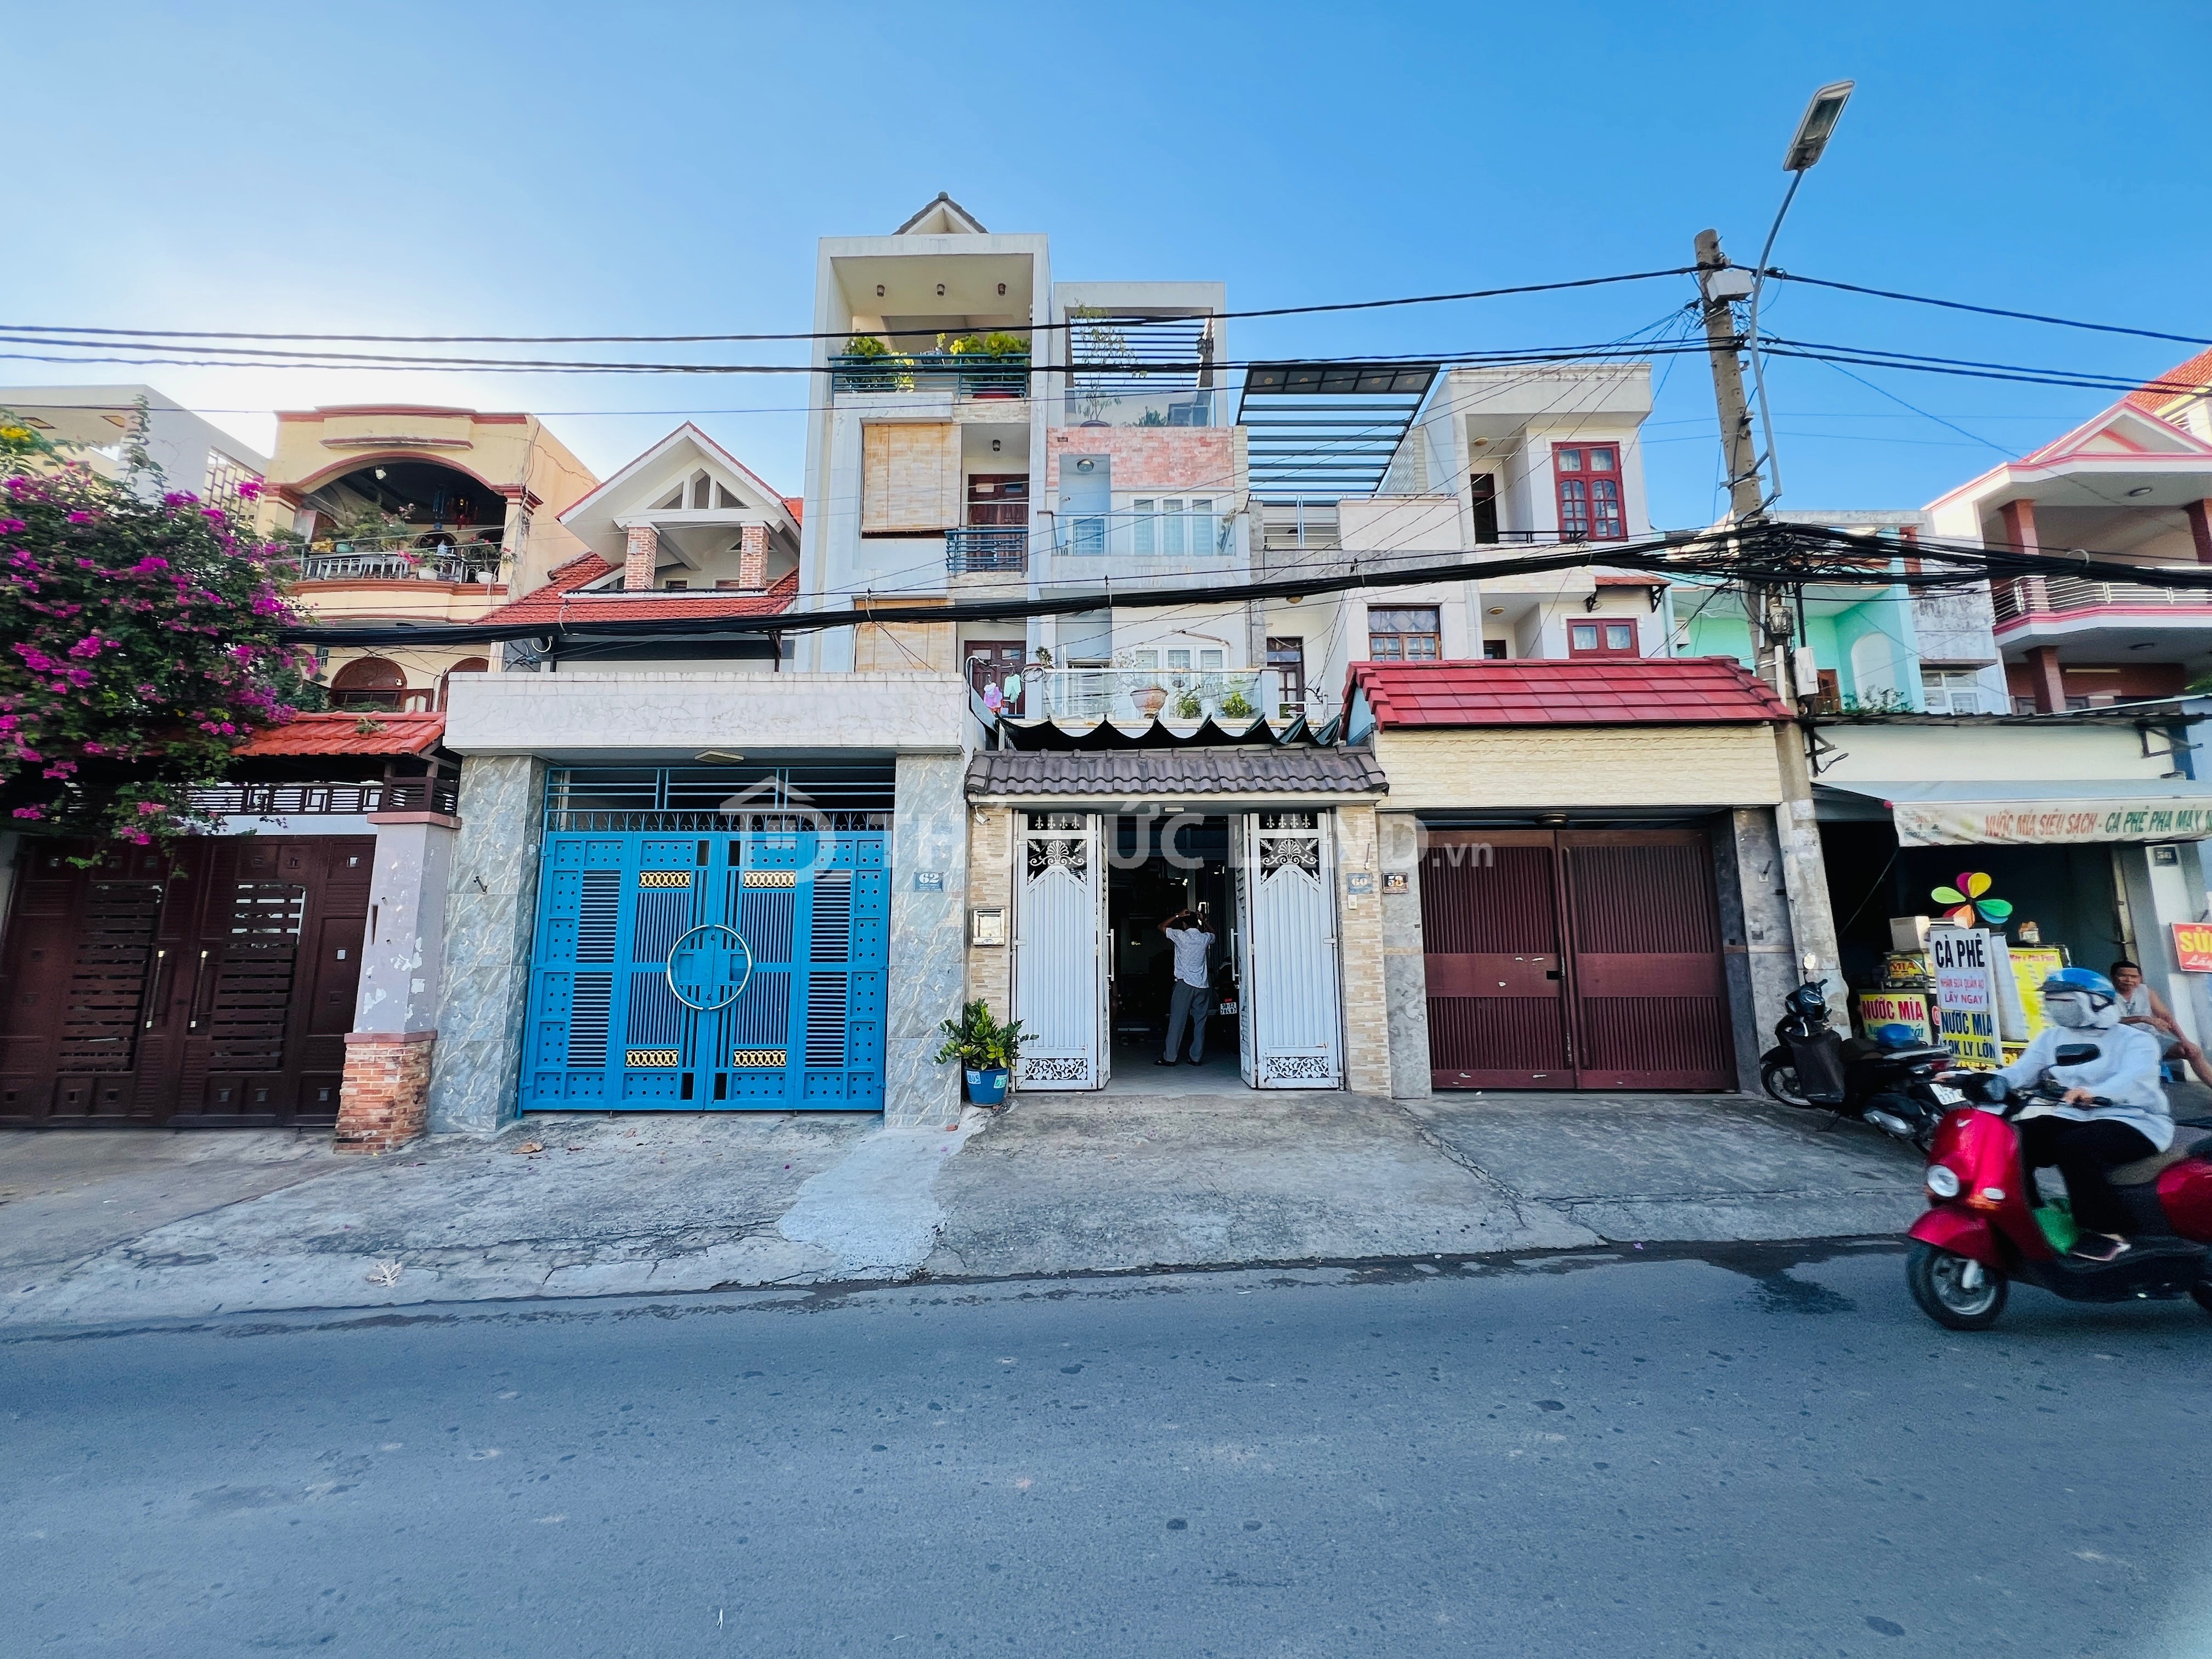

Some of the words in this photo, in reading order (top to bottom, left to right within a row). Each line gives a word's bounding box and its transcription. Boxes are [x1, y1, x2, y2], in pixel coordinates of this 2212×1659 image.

[2148, 811, 2173, 832] PHA
[919, 873, 939, 884] 62
[1352, 877, 1368, 886] 60
[1935, 934, 1954, 968] CÀ
[1956, 933, 1985, 967] PHÊ
[1961, 994, 1983, 1004] NGAY
[1861, 997, 1895, 1020] NƯỚC
[1898, 997, 1925, 1021] MÍA
[1963, 1041, 1973, 1056] LY
